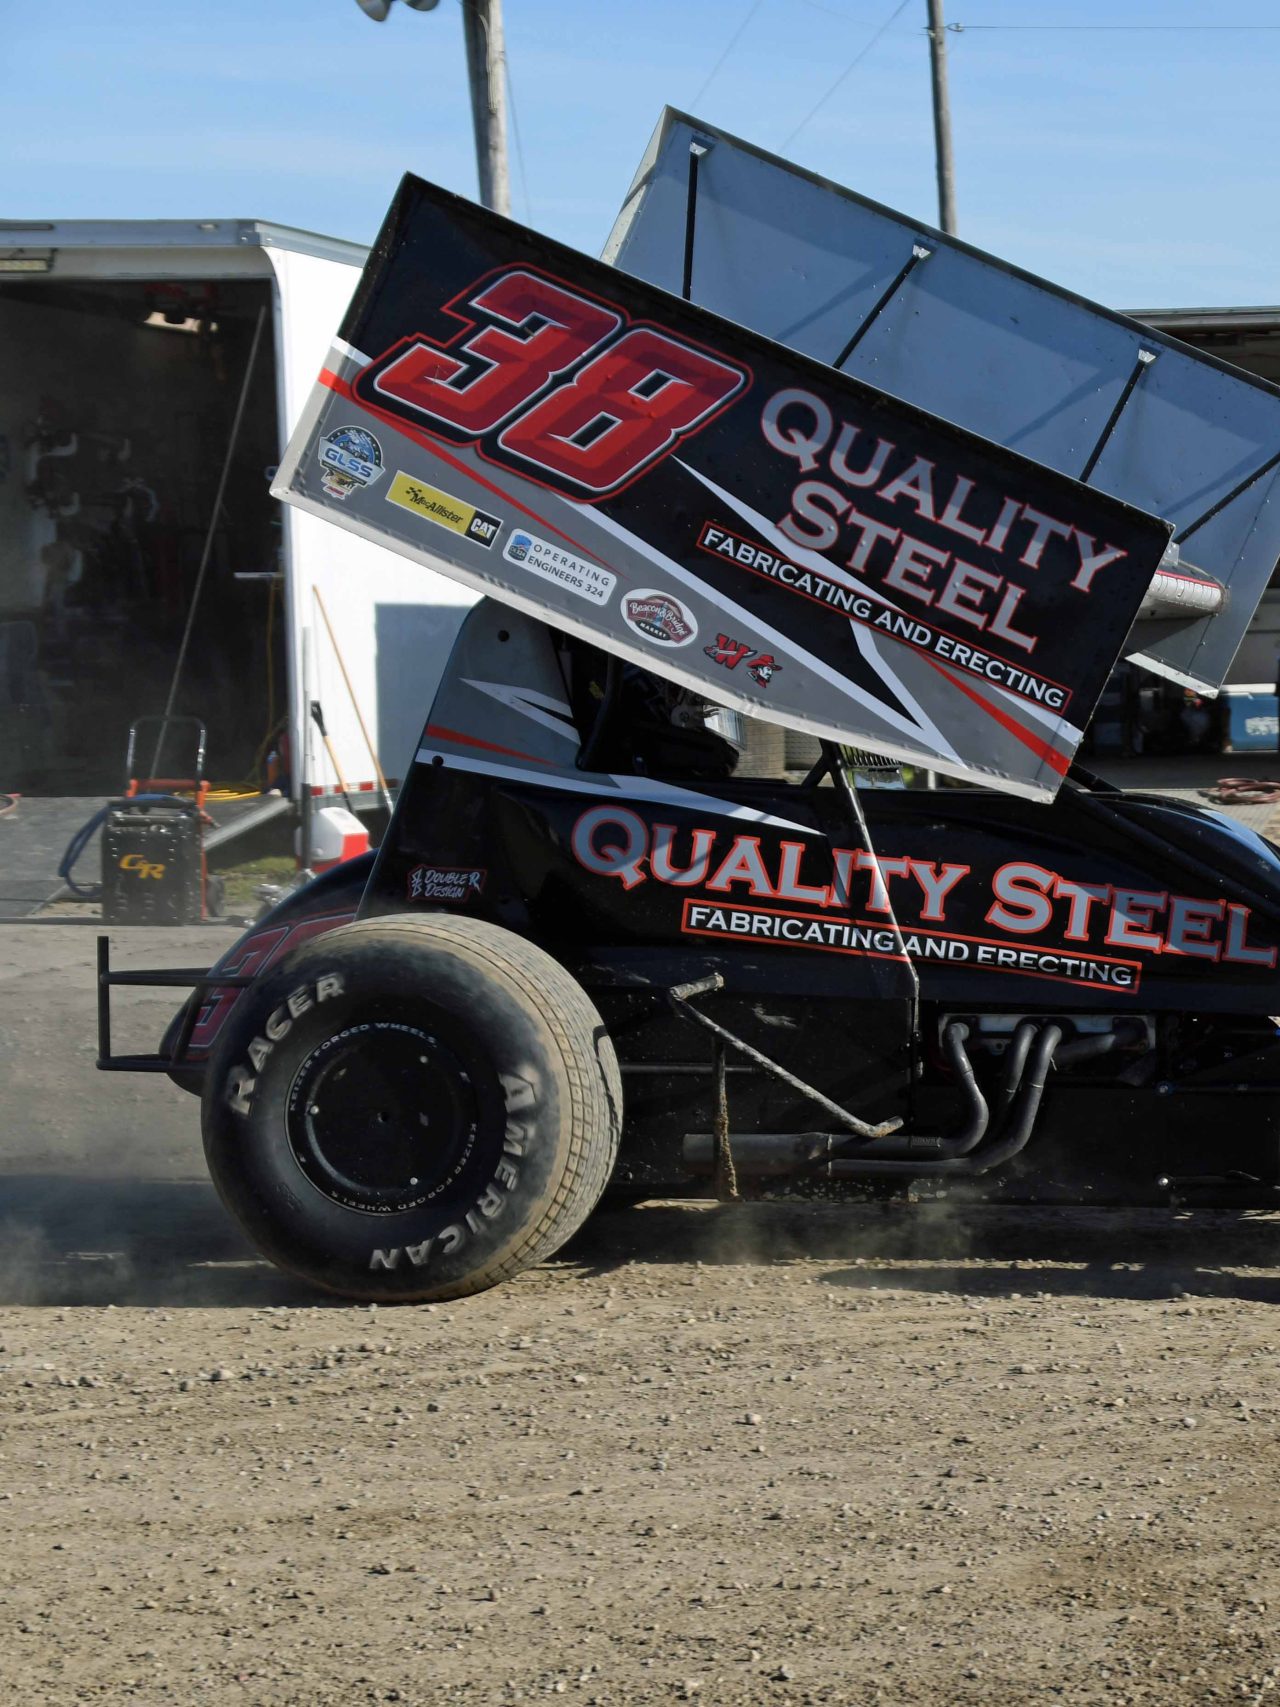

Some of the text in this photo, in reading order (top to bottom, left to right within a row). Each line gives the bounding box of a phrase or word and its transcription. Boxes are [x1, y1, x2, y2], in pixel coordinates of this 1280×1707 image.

[366, 265, 750, 497] 38
[325, 447, 373, 478] GLSS
[761, 389, 1127, 592] QUALITY
[409, 493, 497, 539] MacAllister CAT
[527, 555, 604, 598] ENGINEERS 324
[533, 544, 610, 586] OPERATING
[776, 480, 1038, 654] STEEL
[703, 528, 1065, 709] FABRICATING AND ERECTING
[424, 869, 468, 885] DOUBLE
[424, 883, 464, 898] DESIGN
[573, 808, 1279, 968] QUALITY STEEL
[689, 906, 1133, 985] FABRICATING AND ERECTING
[223, 970, 346, 1117] RACER
[289, 1022, 438, 1111] KEIZER FORGED WHEELS
[370, 1062, 537, 1271] AMERICAN
